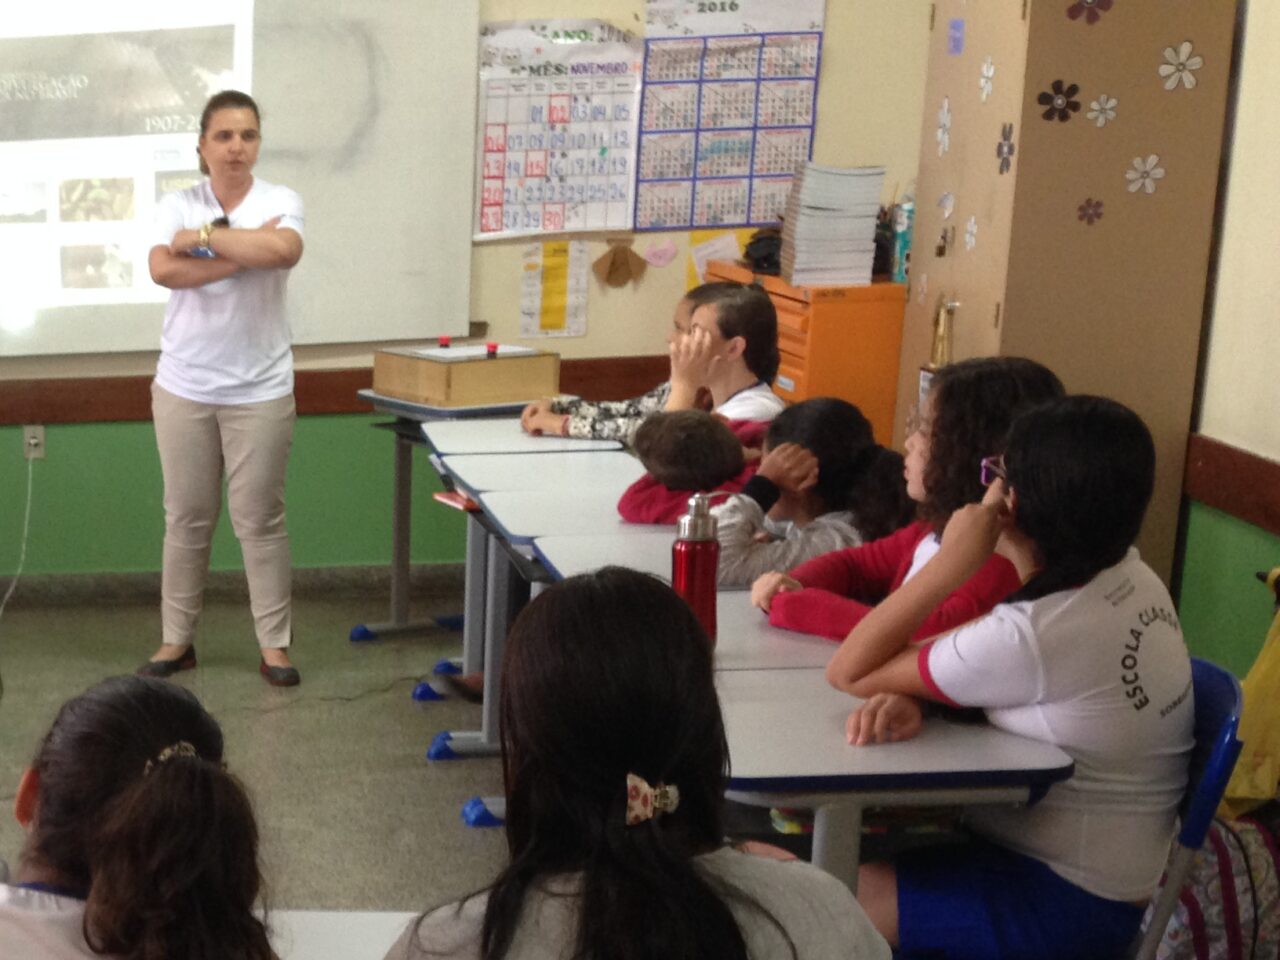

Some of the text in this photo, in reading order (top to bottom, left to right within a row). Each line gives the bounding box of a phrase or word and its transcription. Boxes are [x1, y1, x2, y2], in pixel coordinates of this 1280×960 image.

[697, 1, 739, 13] 2016
[570, 61, 628, 75] NOVEMBRO
[1121, 627, 1150, 712] ESCOLA
